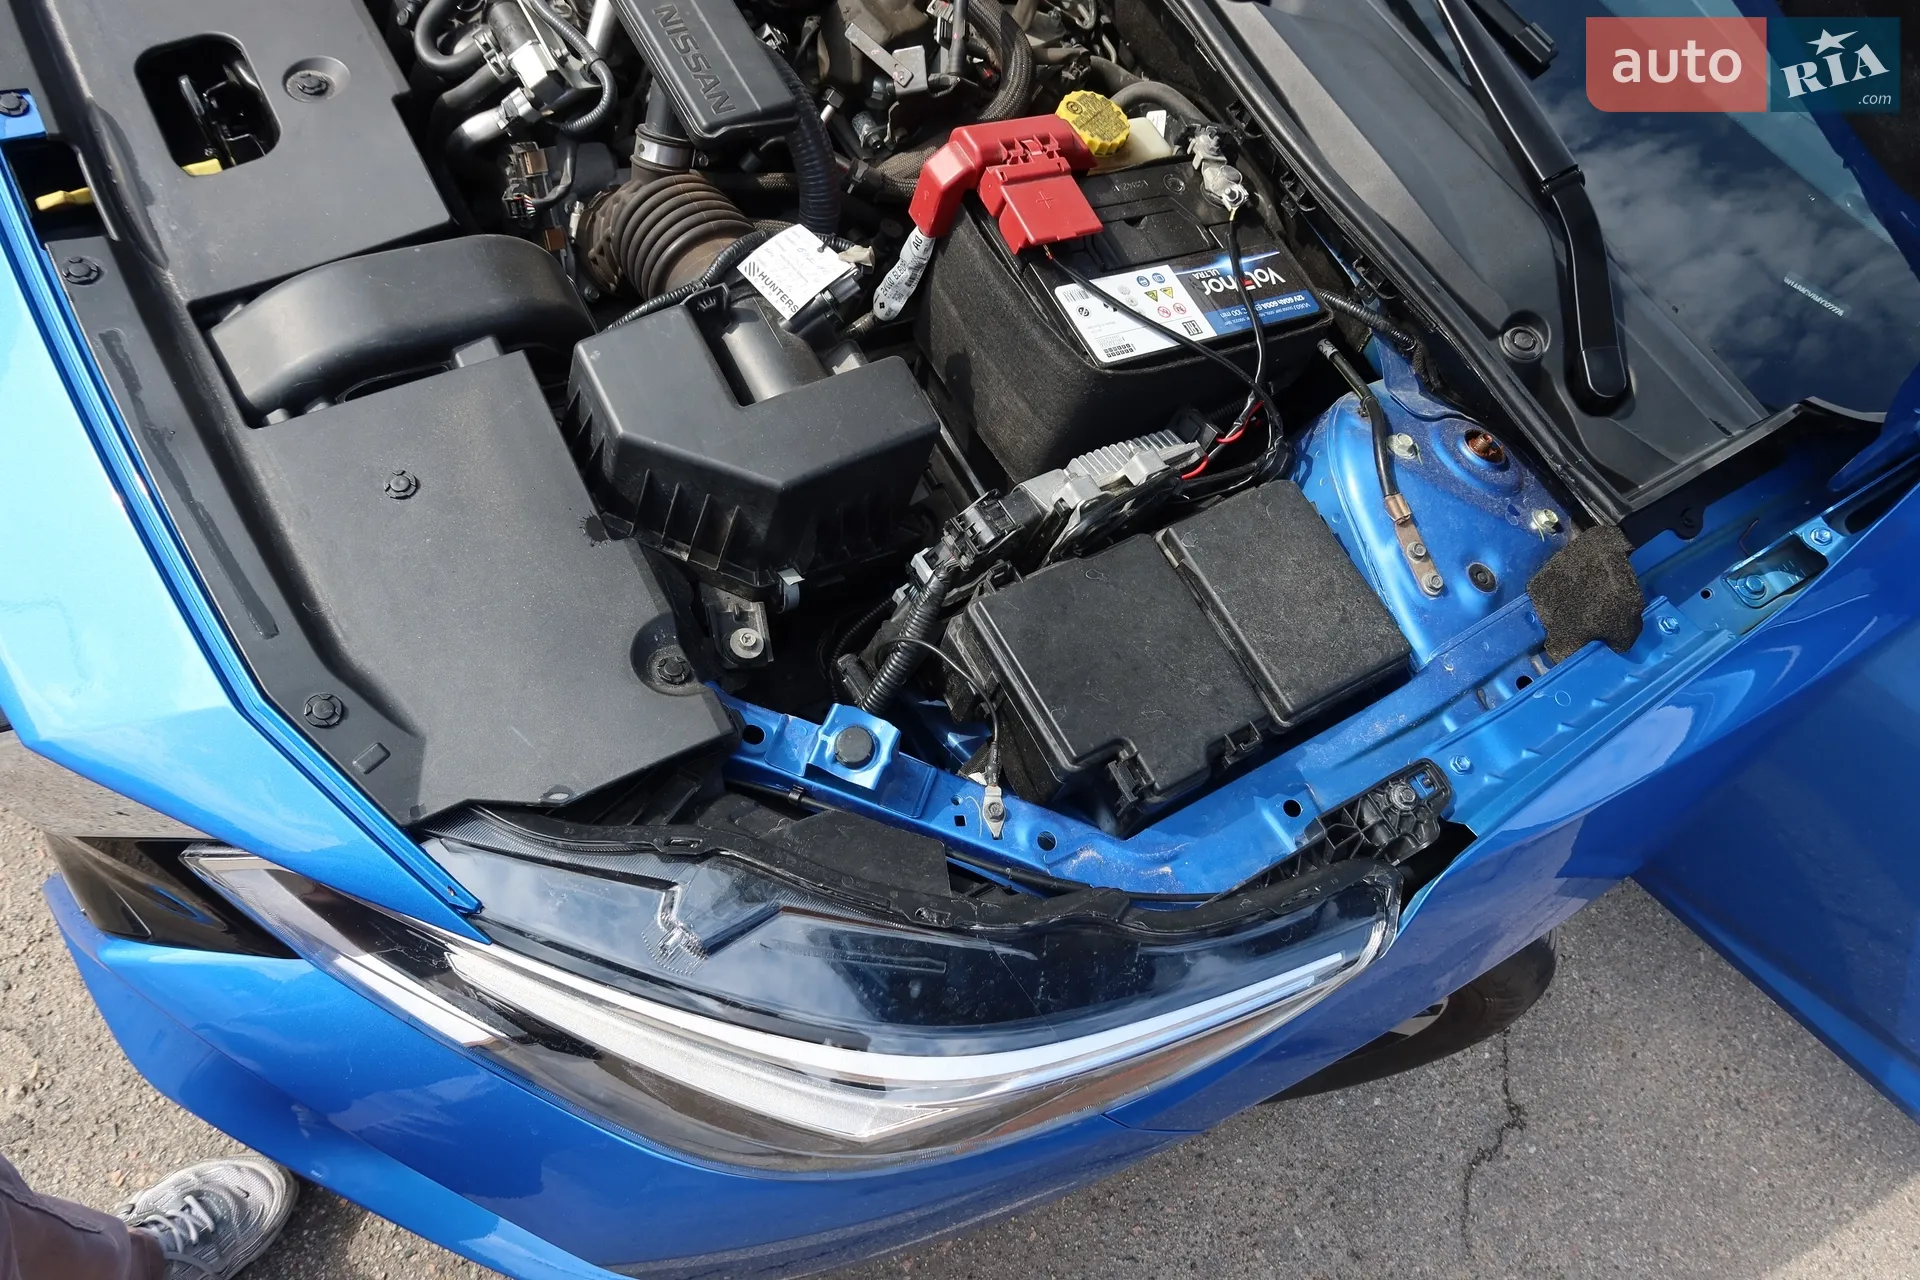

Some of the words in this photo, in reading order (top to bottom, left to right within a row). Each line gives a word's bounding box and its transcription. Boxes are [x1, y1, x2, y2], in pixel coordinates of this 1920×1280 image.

[652, 4, 736, 115] NISSAN
[1192, 268, 1220, 280] ULTRA
[758, 272, 799, 314] HUNTERS
[1293, 295, 1305, 303] 12V
[1231, 308, 1244, 317] 100
